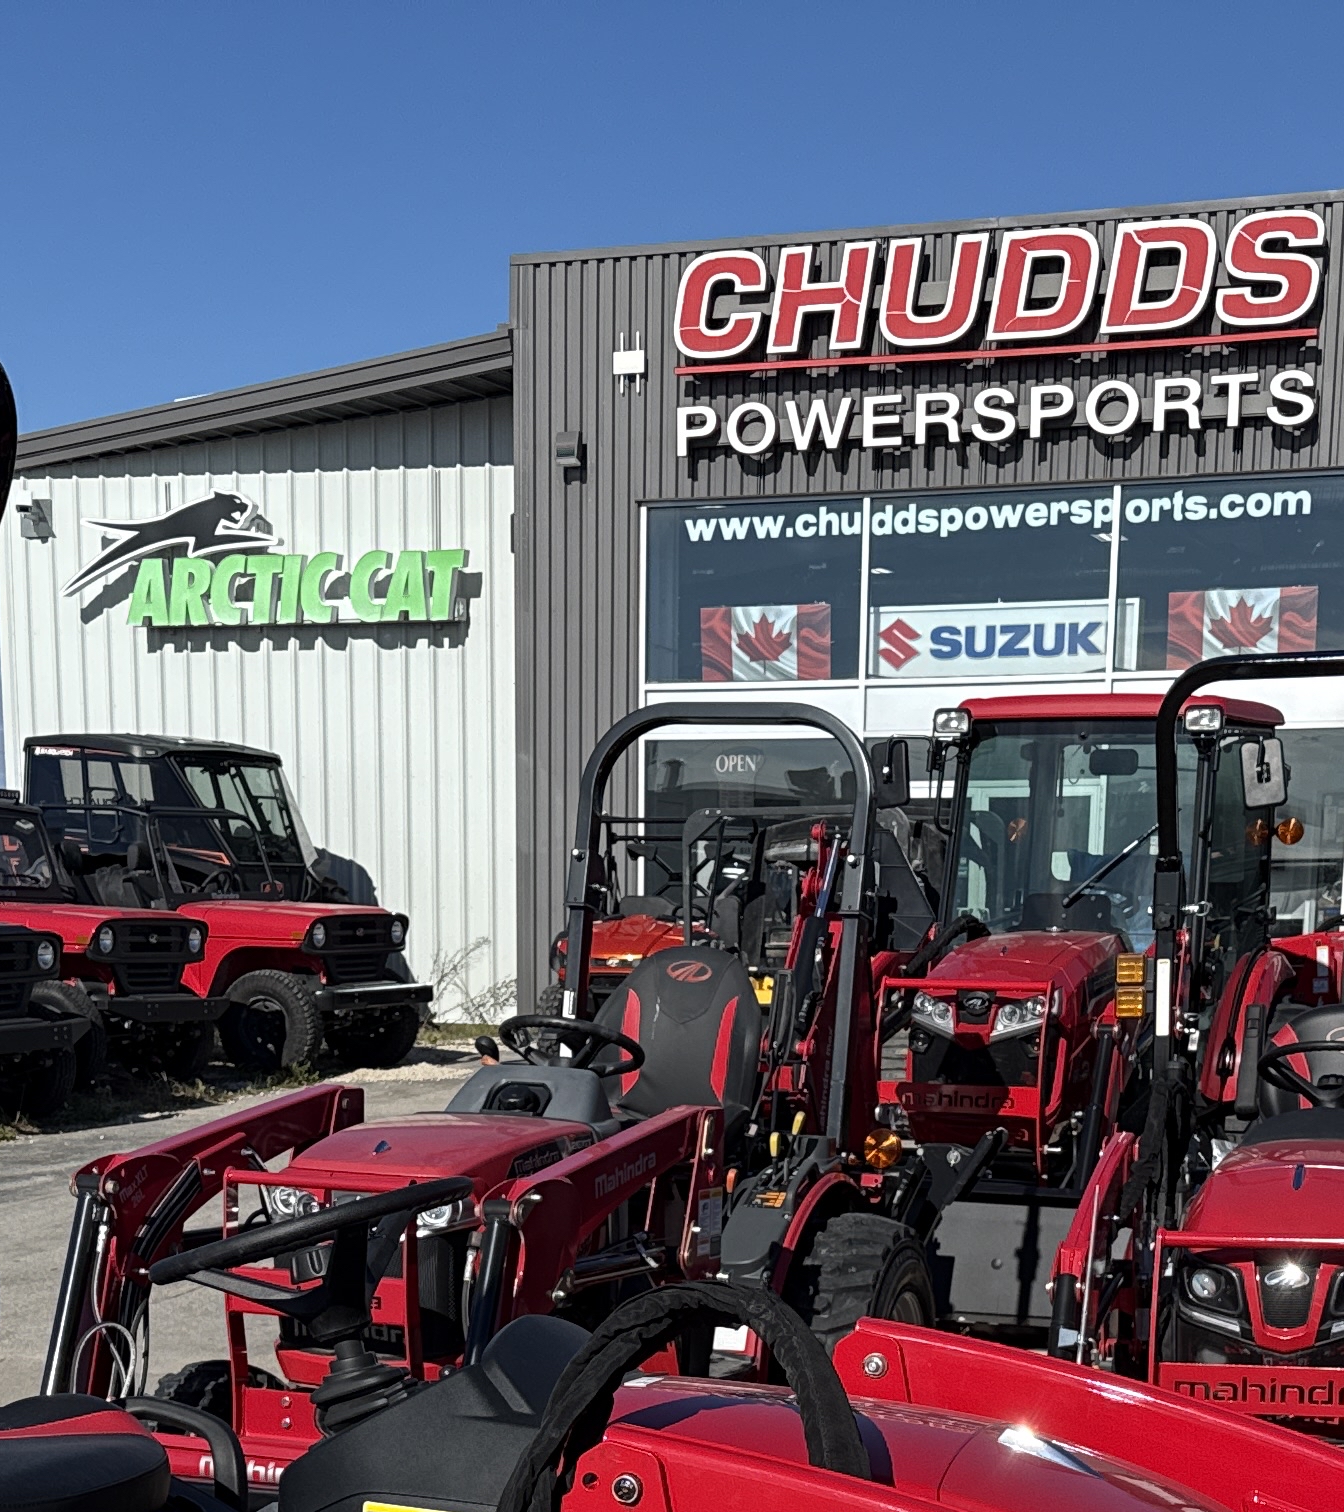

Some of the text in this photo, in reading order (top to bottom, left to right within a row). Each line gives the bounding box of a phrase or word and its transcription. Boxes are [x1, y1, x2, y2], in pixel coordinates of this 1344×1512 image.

[672, 209, 1327, 361] CHUDDS
[675, 369, 1316, 457] POWERSPORTS
[684, 489, 1312, 543] www.chuddspowersports.com
[126, 549, 470, 627] ARCTIC CAT
[929, 621, 1104, 662] SUZUK
[715, 754, 757, 773] OPEN
[594, 1152, 656, 1199] Mahindra
